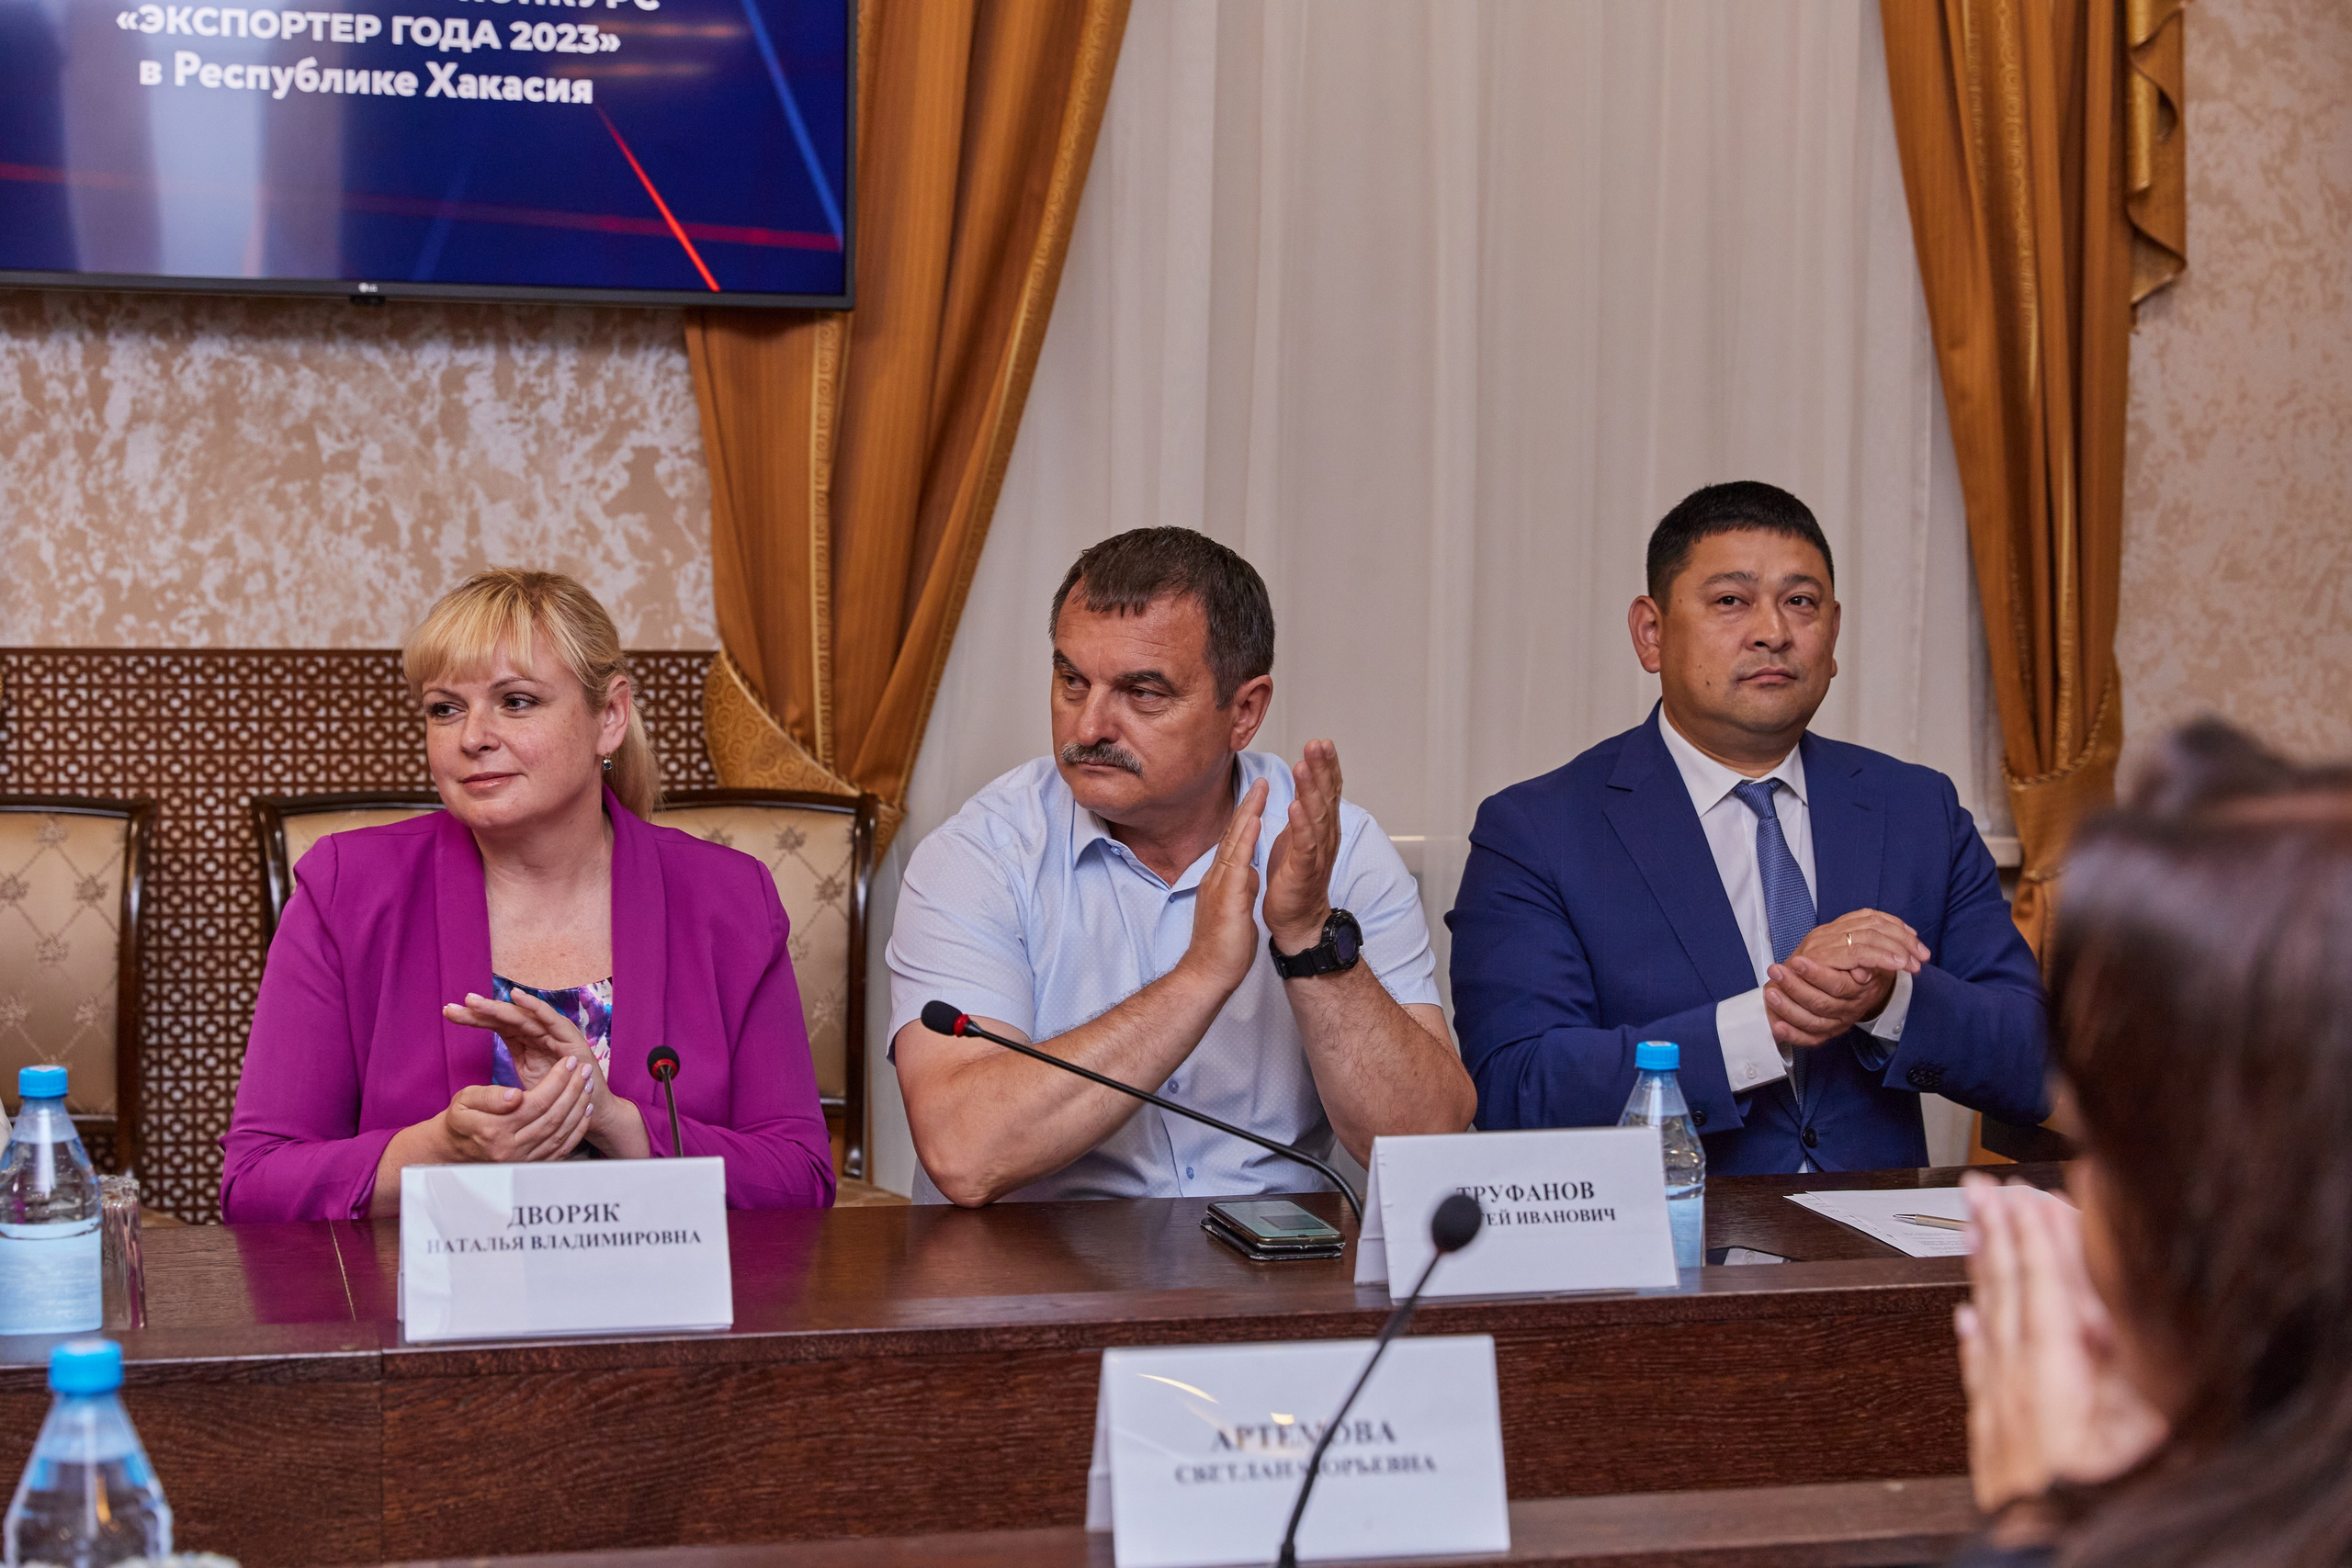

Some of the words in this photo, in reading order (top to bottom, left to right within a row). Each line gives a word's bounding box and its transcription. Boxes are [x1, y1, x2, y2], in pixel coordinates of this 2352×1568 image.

[116, 4, 382, 44] «ЭКСПОРТЕР
[391, 15, 502, 53] ГОДА
[509, 20, 621, 54] 2023»
[139, 60, 164, 85] в
[175, 50, 419, 100] Республике
[424, 61, 594, 105] Хакасия
[507, 1202, 621, 1229] ДВОРЯК
[1516, 1207, 1617, 1224] ИВАНОВИЧ
[427, 1235, 525, 1255] НАТАЛЬЯ
[531, 1229, 702, 1250] ВЛАДИМИРОВНА
